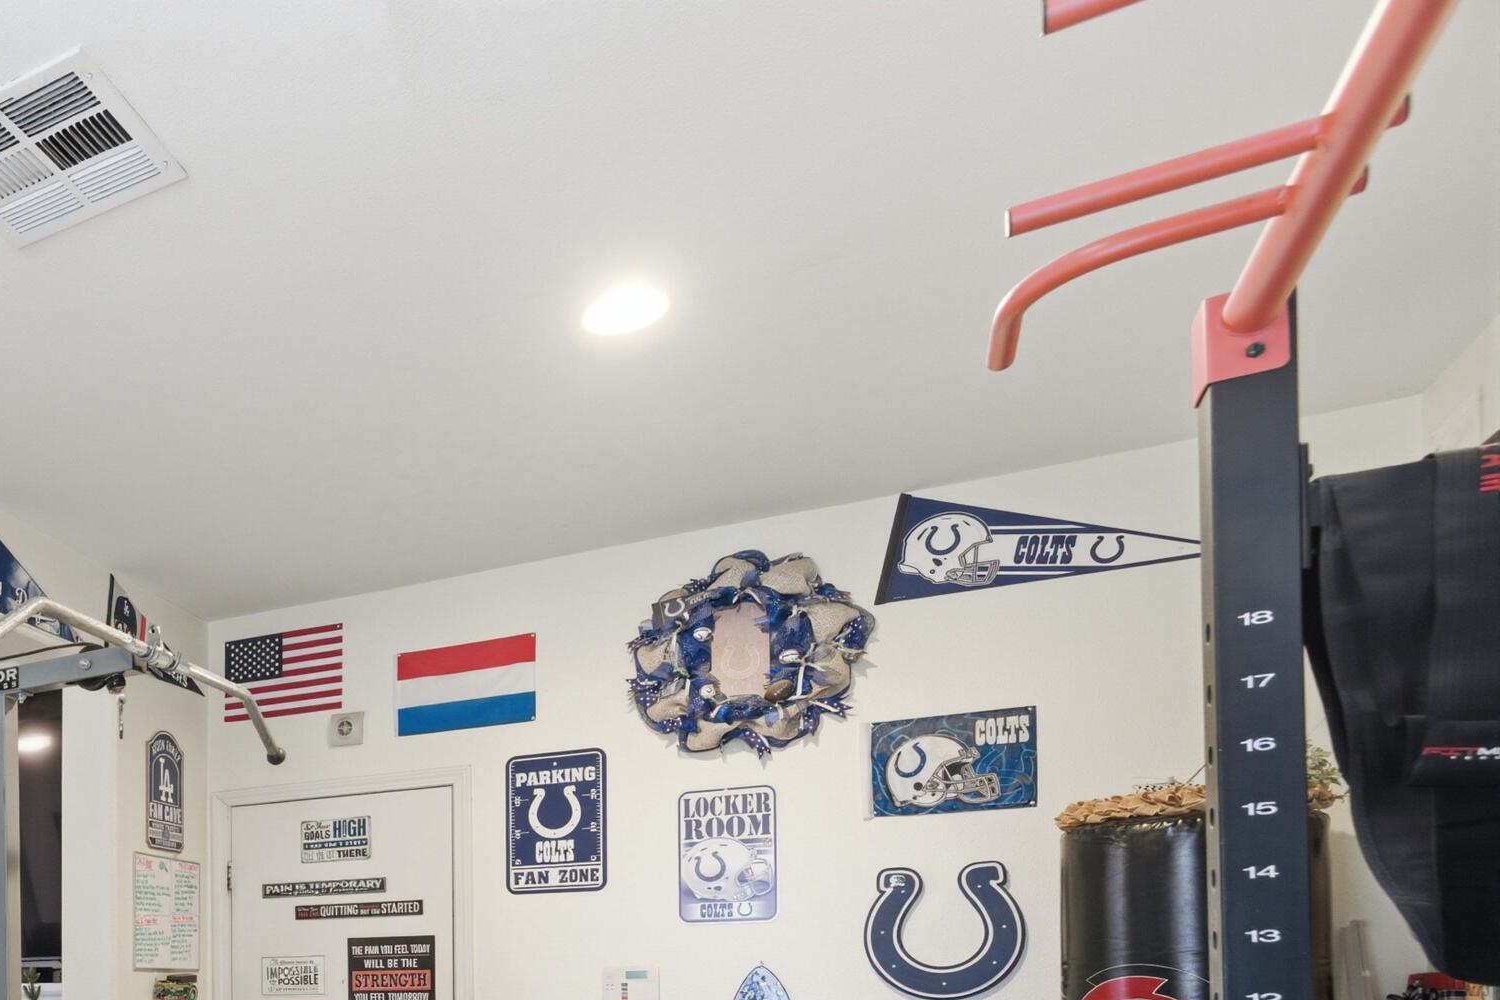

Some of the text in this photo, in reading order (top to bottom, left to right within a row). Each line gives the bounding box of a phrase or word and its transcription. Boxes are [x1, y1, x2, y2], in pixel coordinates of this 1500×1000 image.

[1013, 535, 1077, 565] COLTS
[1236, 609, 1275, 626] 18
[1240, 672, 1276, 689] 17
[974, 714, 1030, 747] COLTS
[1240, 736, 1277, 753] 16
[159, 757, 174, 803] LA
[515, 766, 596, 787] PARKING
[683, 792, 771, 818] LOCKER
[1241, 800, 1279, 816] 15
[304, 830, 330, 840] GOALS
[333, 818, 366, 838] HIGH
[684, 814, 771, 840] ROOM
[337, 848, 367, 857] THERE
[535, 839, 575, 863] COLTS
[513, 868, 600, 885] FAN ZONE
[1242, 864, 1280, 880] 14
[266, 885, 292, 894] PAIN
[296, 883, 305, 891] IS
[309, 879, 382, 890] TEMPORARY
[320, 905, 358, 917] QUITTING
[381, 902, 419, 914] STARTED
[700, 903, 733, 918] COLTS
[1243, 928, 1282, 944] 13
[352, 944, 430, 955] THE PAIN YOU FEEL TODAY
[364, 958, 418, 968] WILL BE THE
[267, 966, 319, 980] IMPOSSIBLE
[278, 974, 318, 985] POSSIBLE
[355, 973, 427, 988] STRENGTH
